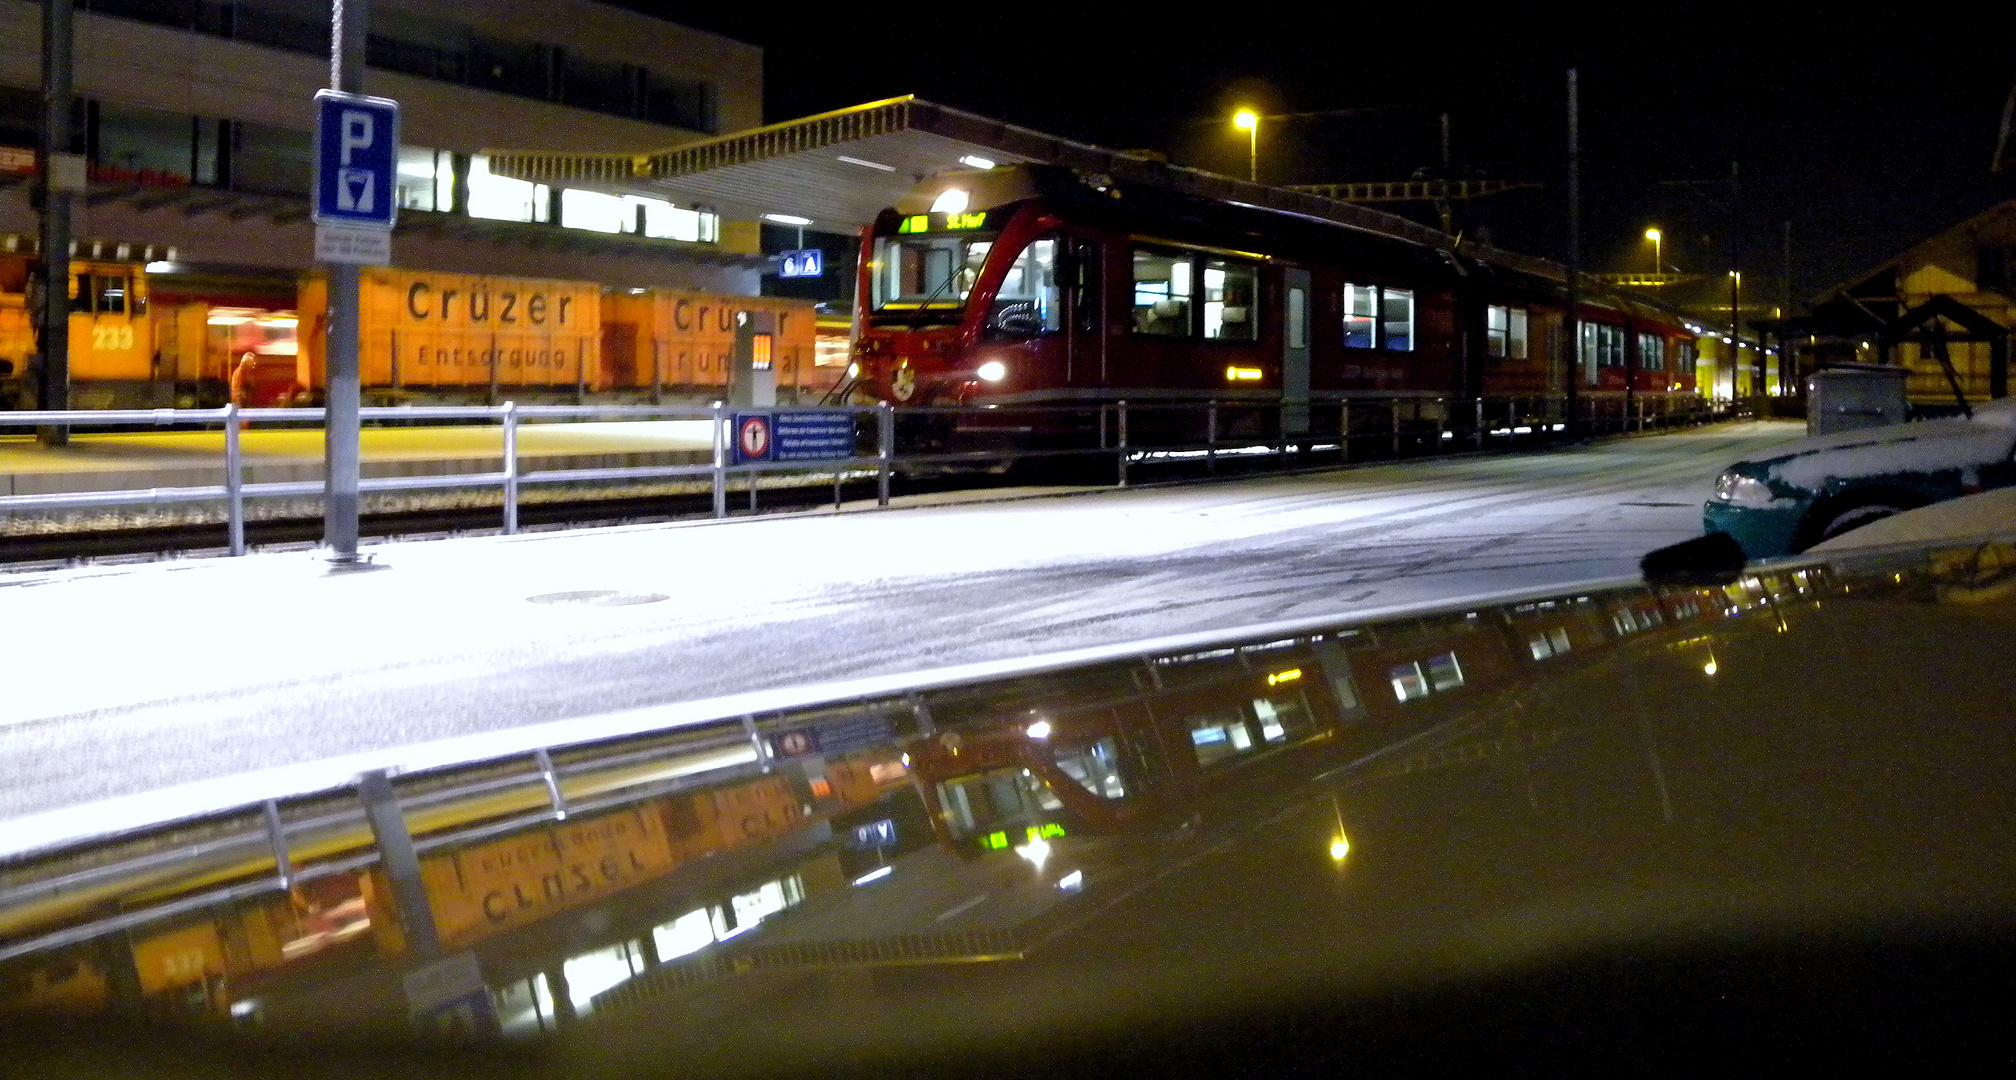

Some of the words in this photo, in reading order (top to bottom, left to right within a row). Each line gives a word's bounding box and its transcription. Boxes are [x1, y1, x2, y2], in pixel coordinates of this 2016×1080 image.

[341, 110, 374, 165] P
[784, 257, 794, 273] 6
[805, 256, 816, 272] A
[407, 280, 571, 325] Crüzer
[674, 298, 788, 335] Crür
[92, 324, 133, 350] 233
[419, 346, 565, 368] Entsorgung
